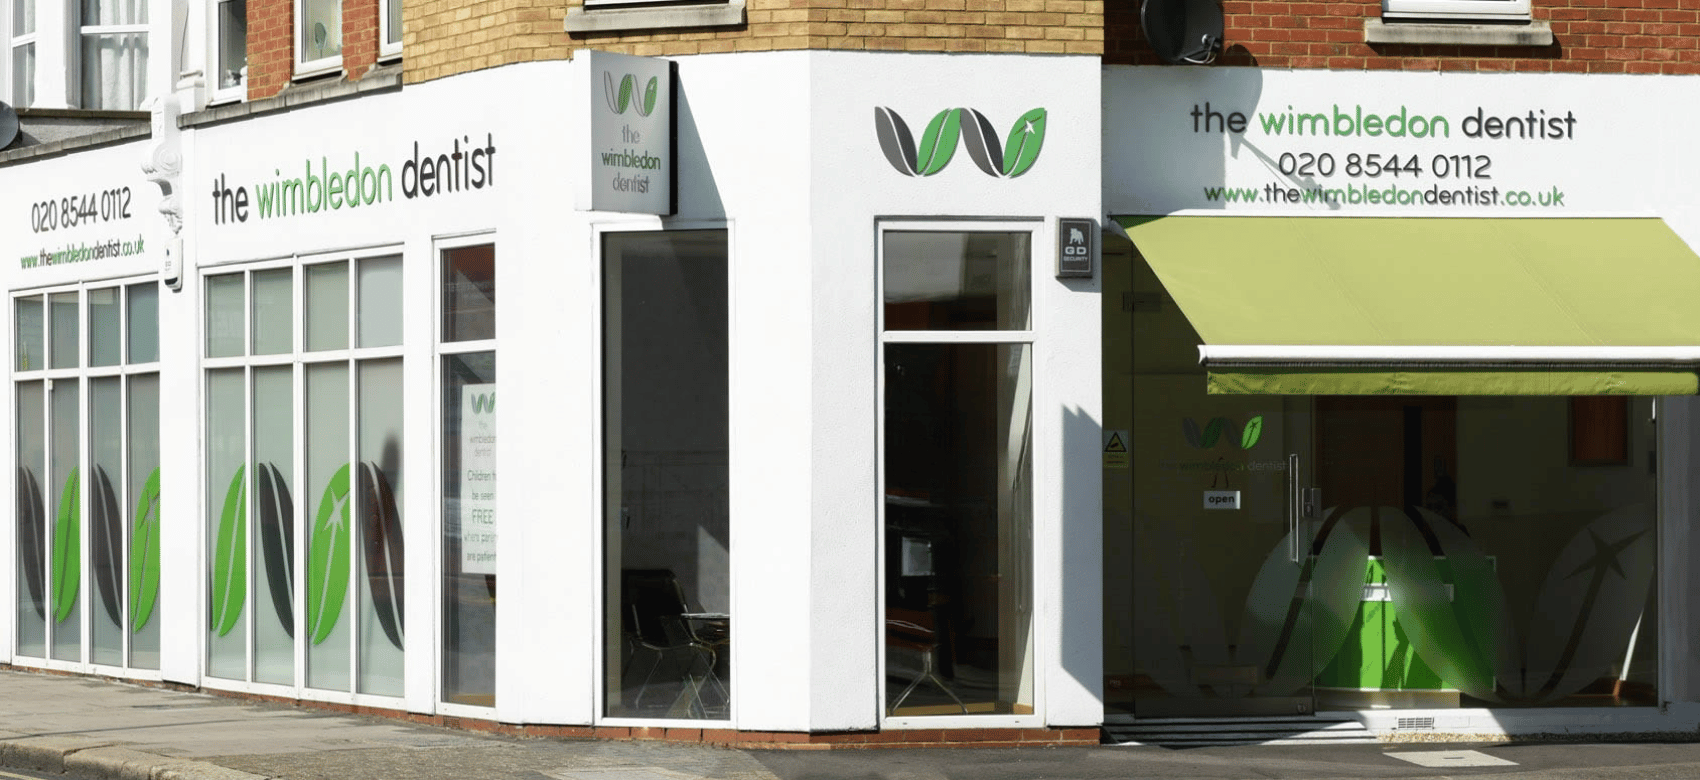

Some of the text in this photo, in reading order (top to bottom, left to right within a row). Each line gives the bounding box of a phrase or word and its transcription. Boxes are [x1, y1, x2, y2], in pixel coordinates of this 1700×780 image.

[1190, 101, 1577, 140] the wimbledon dentist
[622, 124, 640, 143] the
[601, 148, 661, 170] wimbledon
[1278, 152, 1492, 179] 020 8544 0112
[212, 132, 497, 225] the wimbledon dentist
[612, 171, 649, 194] dentist
[1203, 183, 1565, 207] www.thewimbledondentist.co.uk
[31, 186, 132, 234] 020 8544 0112
[20, 233, 145, 270] www.thewimbledondentist.co.uk
[466, 469, 491, 482] Children
[1208, 494, 1235, 505] open
[472, 509, 494, 525] FREE
